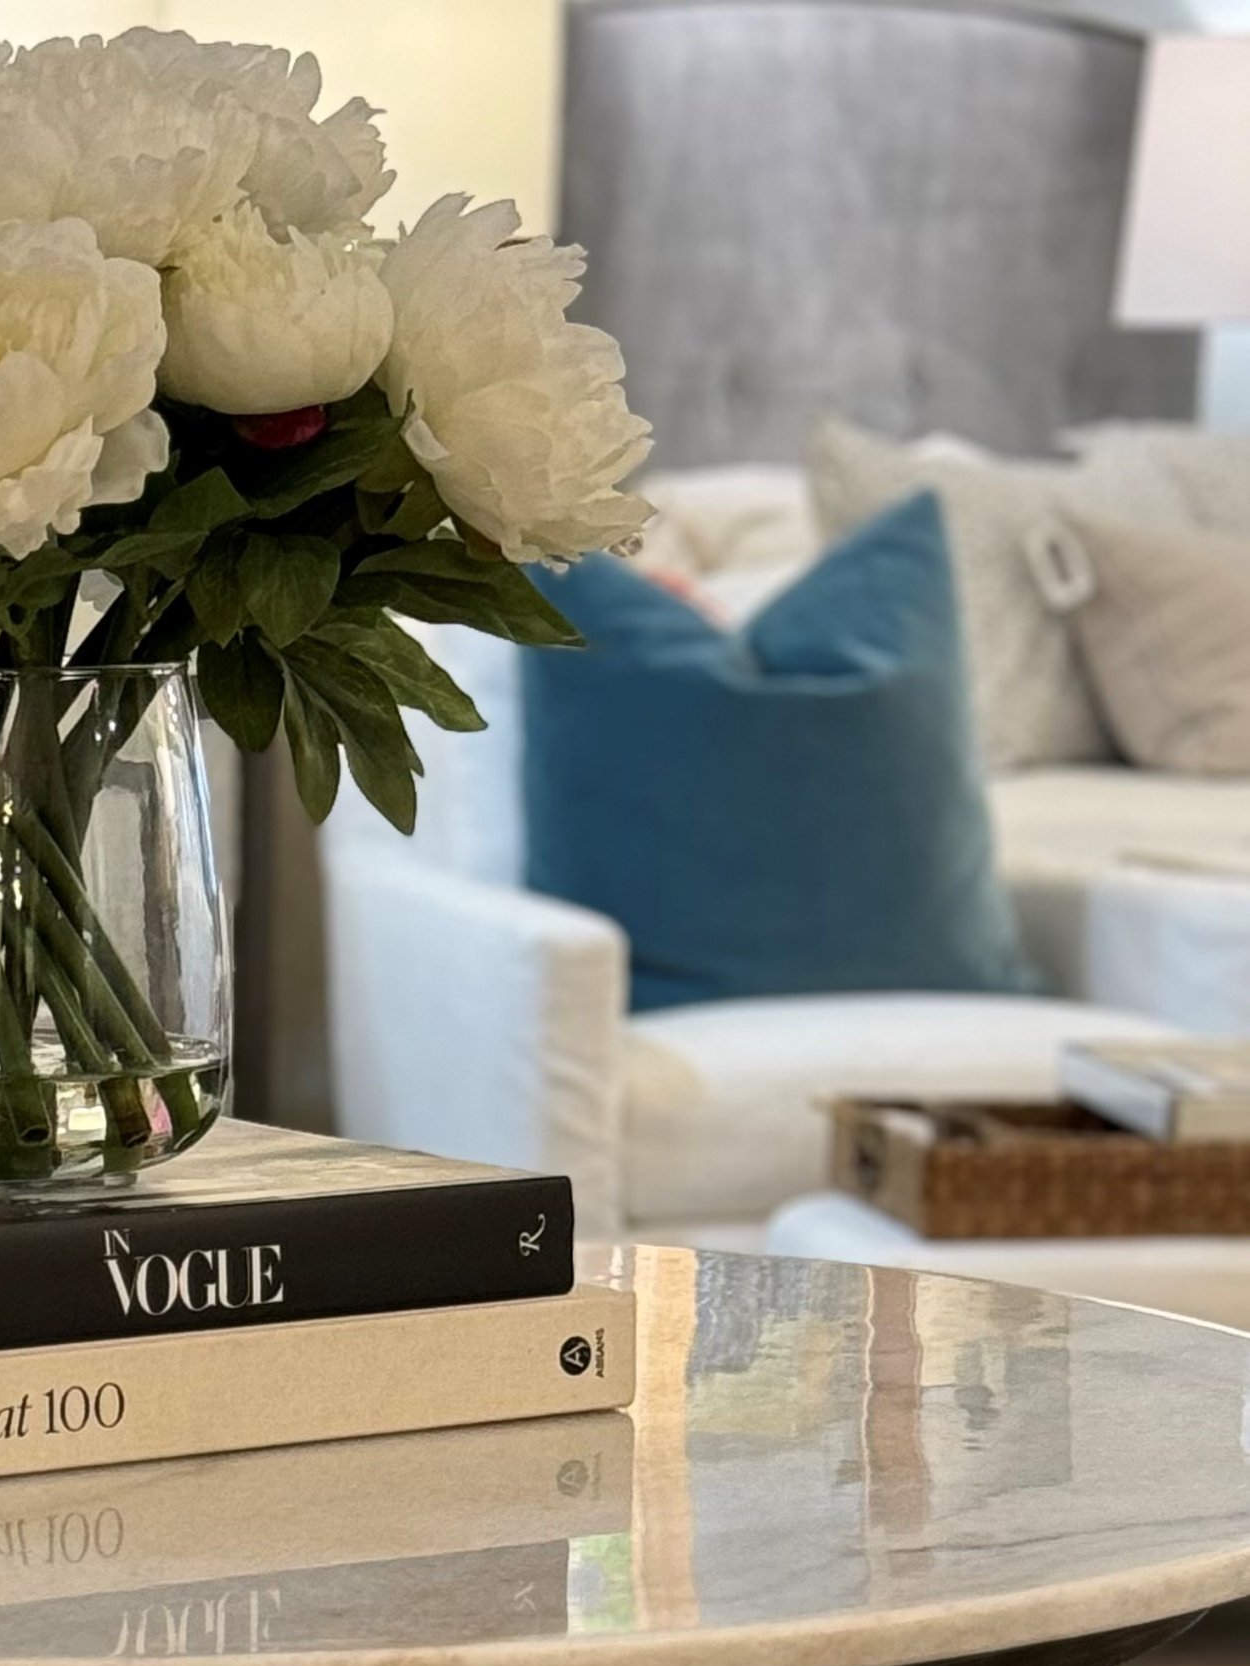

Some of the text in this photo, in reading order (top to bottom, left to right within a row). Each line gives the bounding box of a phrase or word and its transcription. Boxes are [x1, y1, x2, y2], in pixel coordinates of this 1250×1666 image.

[103, 1228, 131, 1257] IN
[518, 1213, 547, 1257] R
[103, 1244, 284, 1318] VOGUE
[42, 1381, 126, 1435] 100
